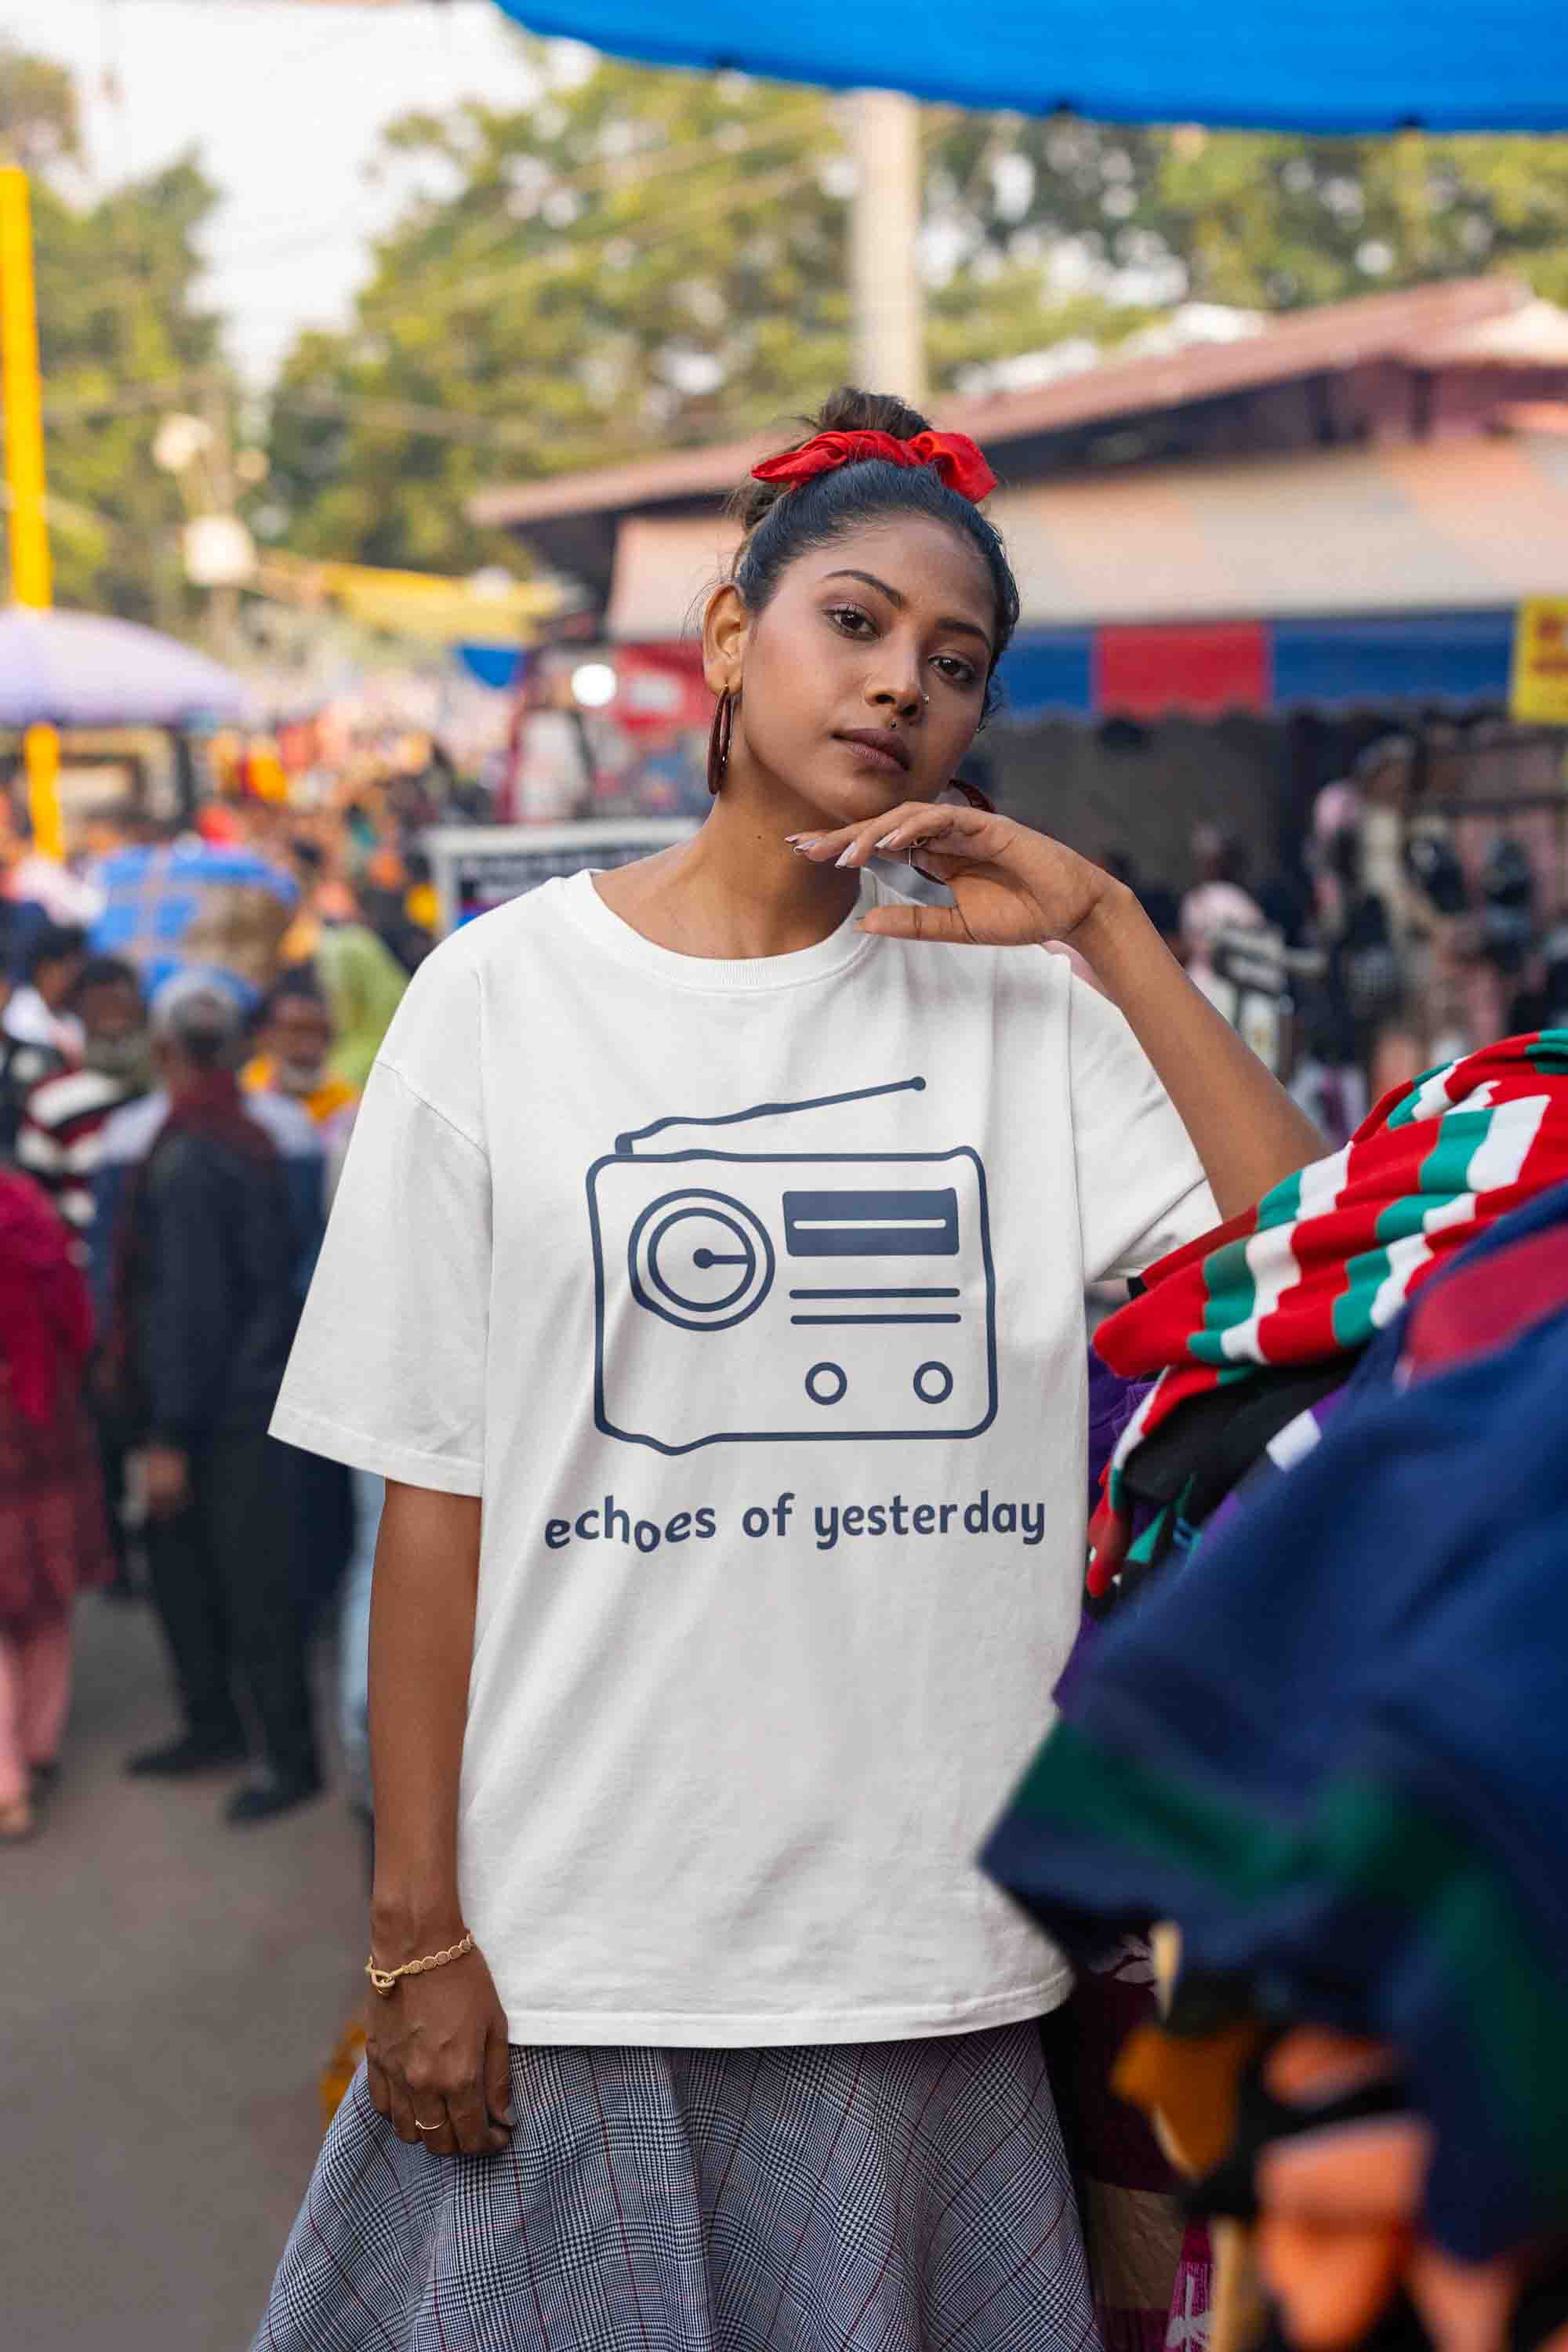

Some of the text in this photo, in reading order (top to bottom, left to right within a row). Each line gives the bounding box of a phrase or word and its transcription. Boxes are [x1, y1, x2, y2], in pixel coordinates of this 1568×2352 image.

[544, 1489, 1045, 1553] echoes of yesterday
